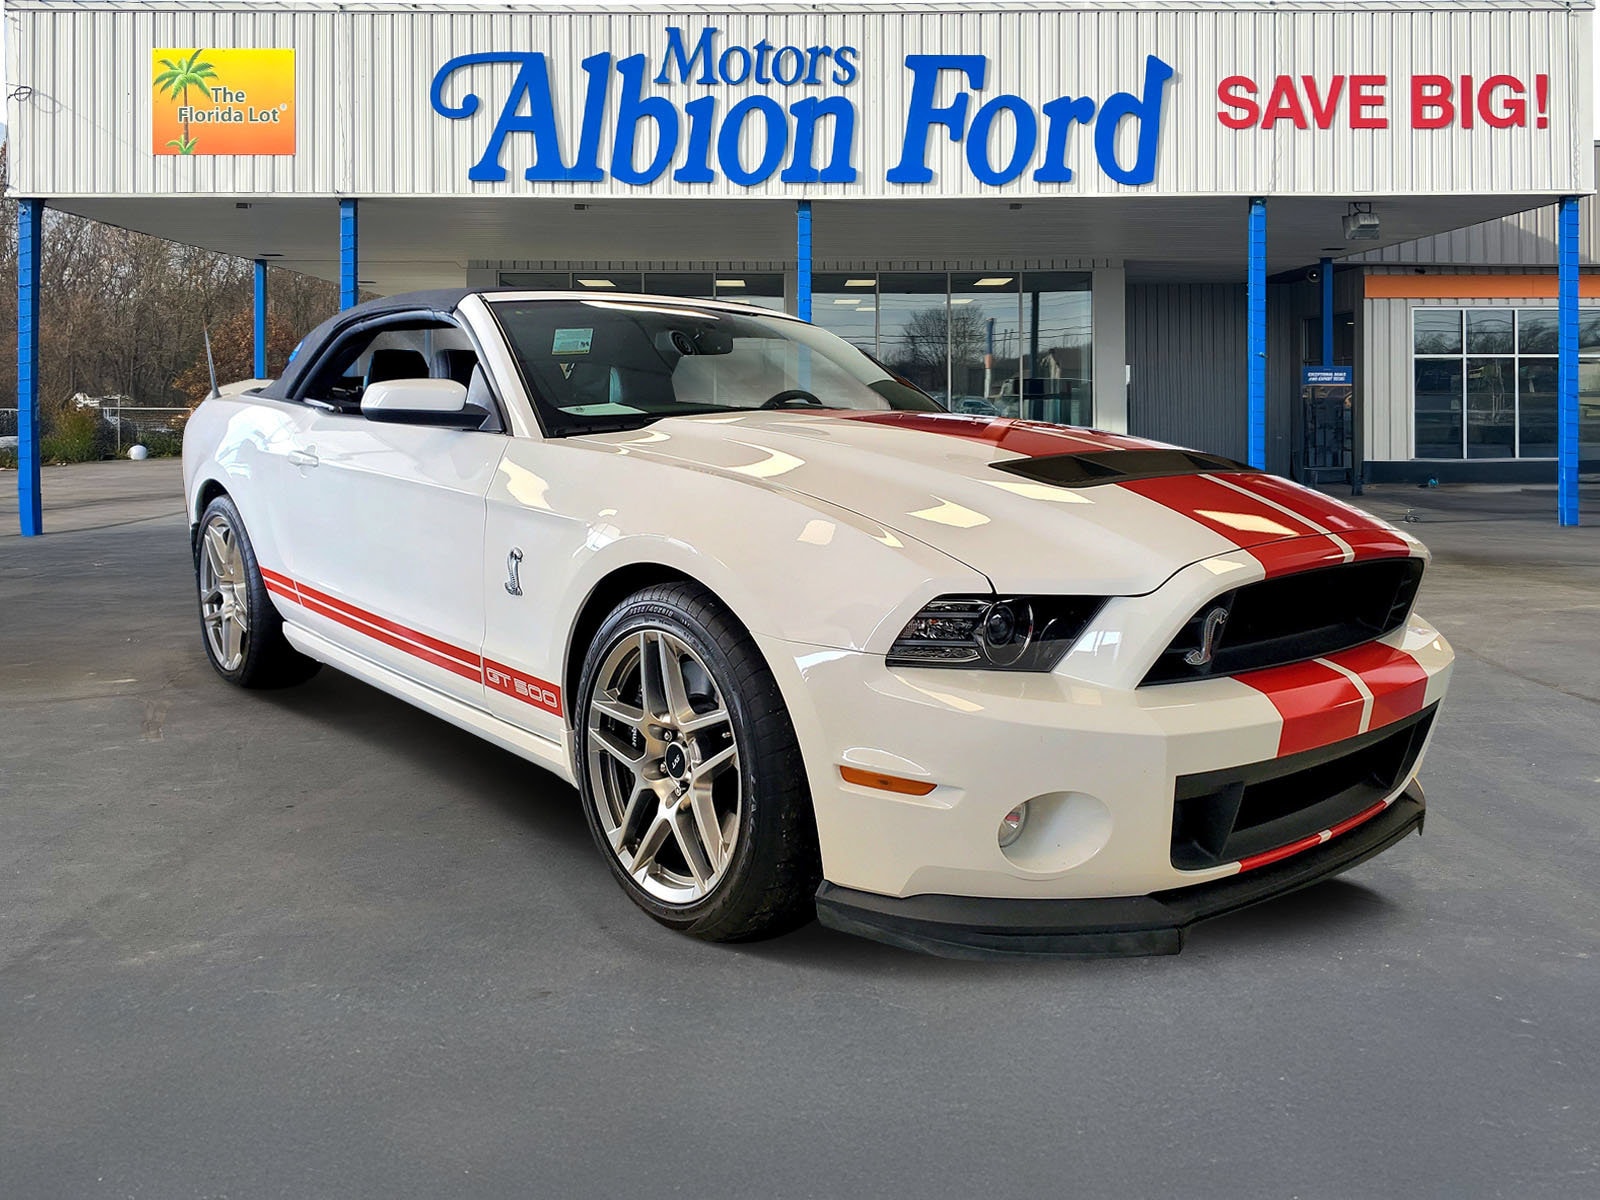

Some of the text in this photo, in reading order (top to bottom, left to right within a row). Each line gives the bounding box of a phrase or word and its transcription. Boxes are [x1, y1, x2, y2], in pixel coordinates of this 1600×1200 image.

[653, 27, 857, 85] Motors
[178, 106, 279, 123] Florida Lot
[211, 87, 245, 103] The
[430, 51, 1174, 186] Albion Ford
[1217, 74, 1548, 129] SAVE BIG!
[486, 667, 557, 708] GT 500
